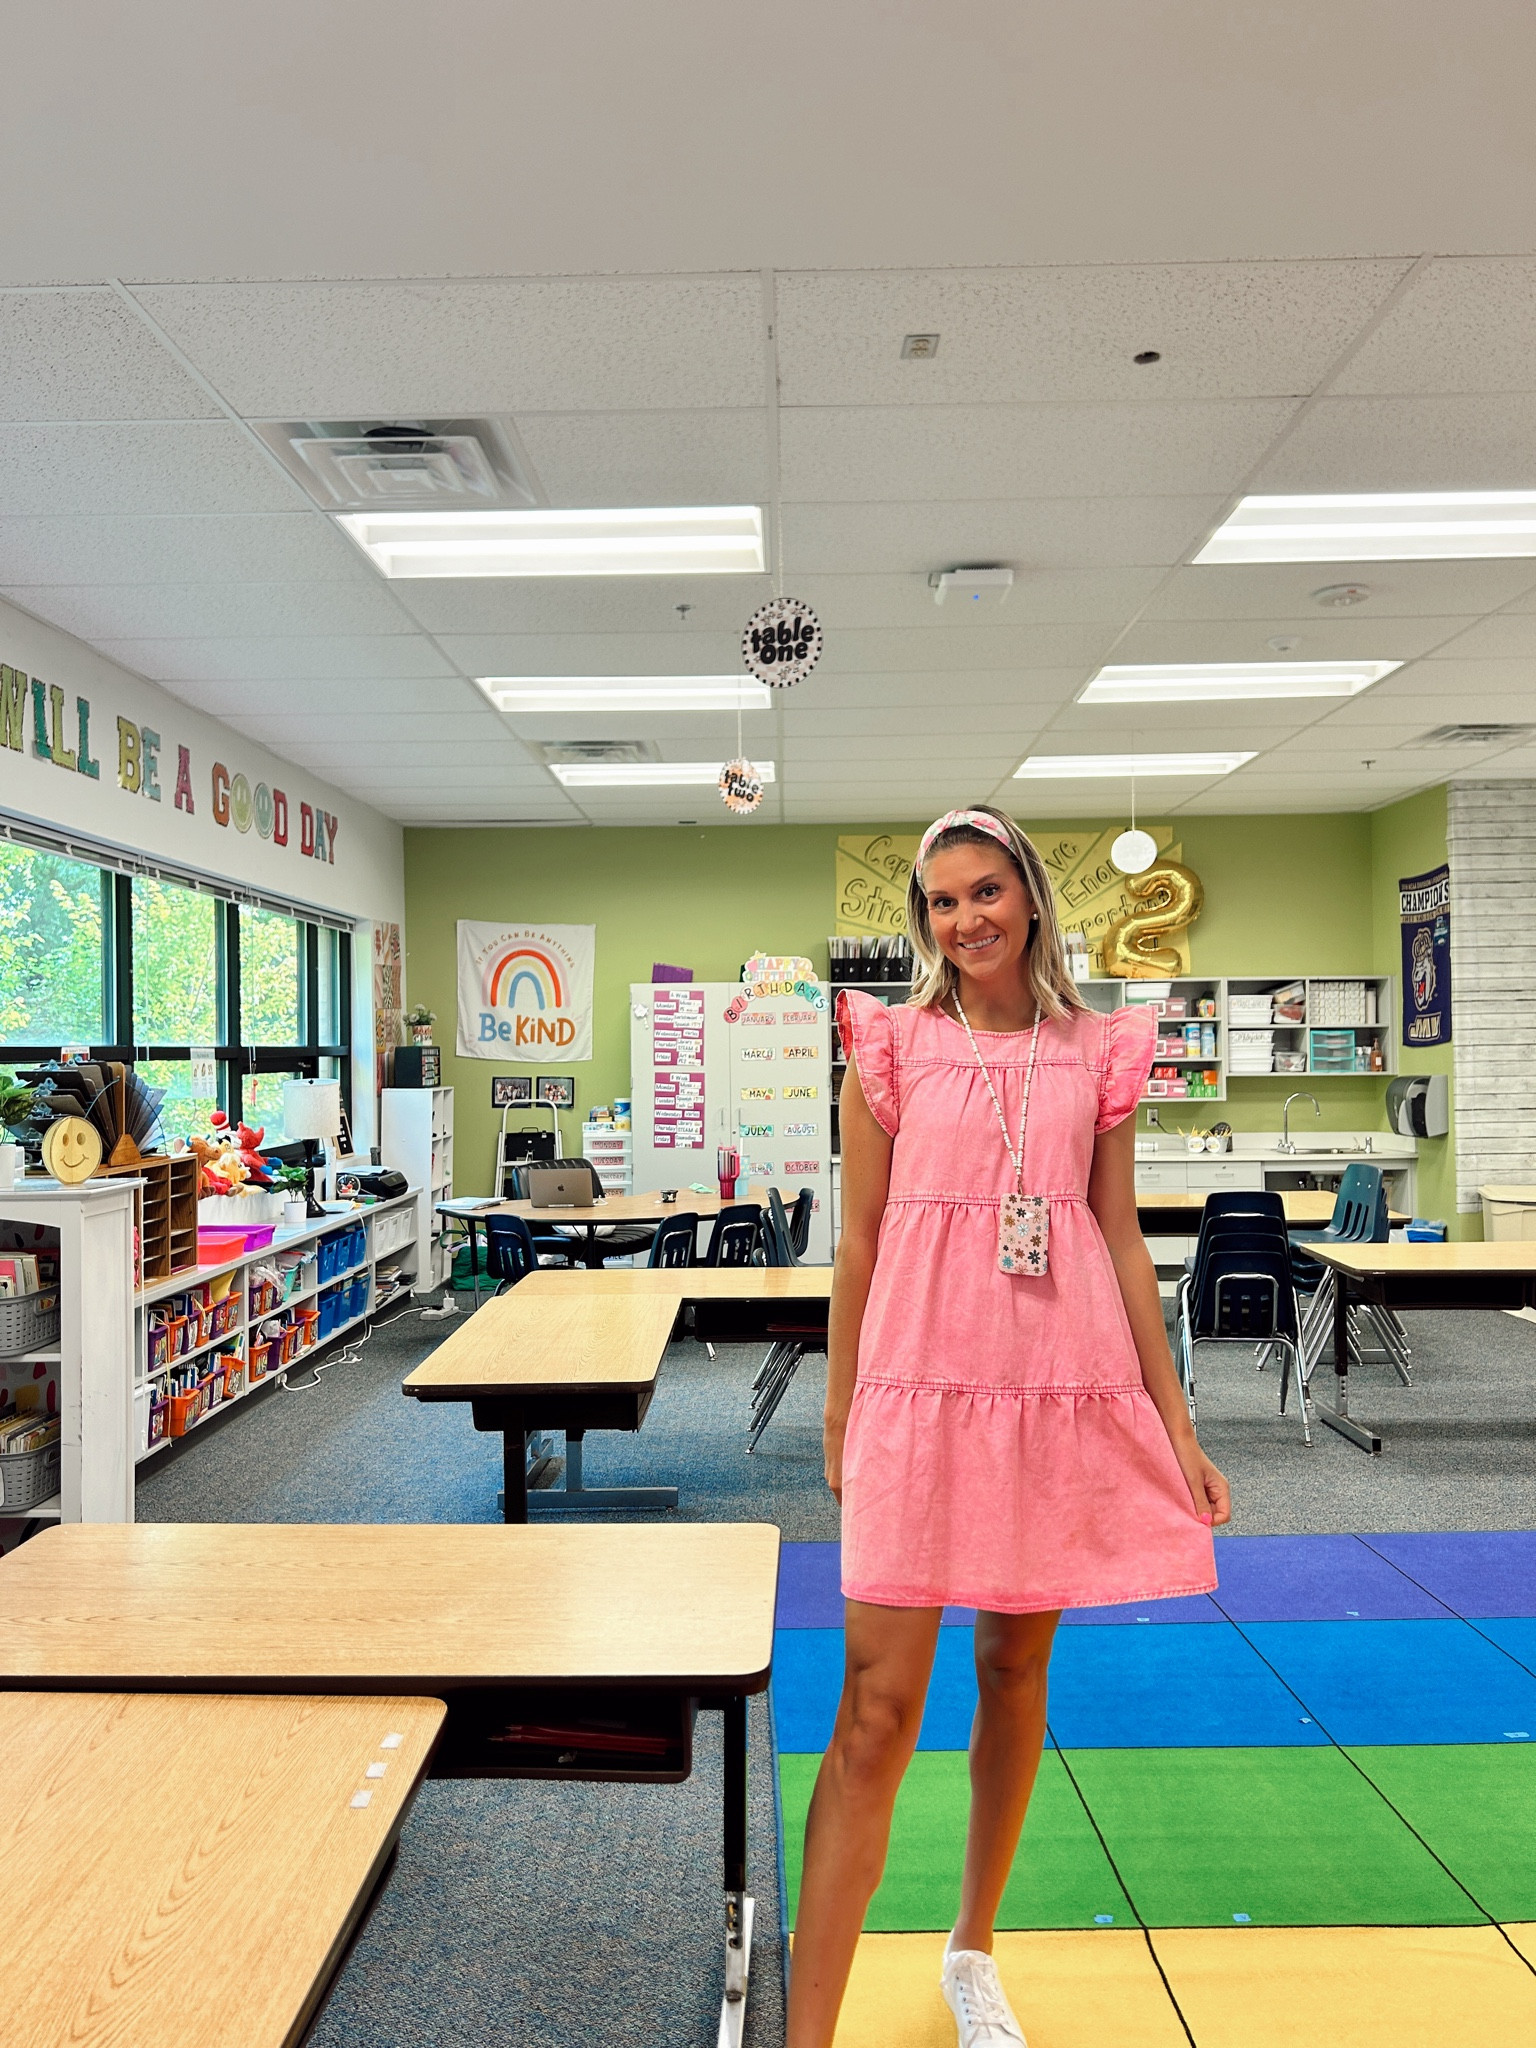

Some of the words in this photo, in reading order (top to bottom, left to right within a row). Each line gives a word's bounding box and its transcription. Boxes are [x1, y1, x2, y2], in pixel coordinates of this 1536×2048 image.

[750, 617, 814, 653] table
[760, 642, 808, 664] one
[0, 663, 100, 780] WILL
[117, 715, 161, 802] BE
[174, 744, 195, 815] A
[211, 761, 289, 847] GOOD
[300, 801, 338, 865] DAY
[725, 770, 759, 794] table
[728, 782, 754, 802] two
[865, 835, 911, 880] Cap
[841, 878, 906, 929] Stro
[1401, 882, 1449, 912] CHAMPIONS
[758, 958, 799, 970] HAPPY
[726, 982, 825, 1020] BIRTHDAYS
[477, 1012, 512, 1042] Be
[516, 1014, 575, 1046] KiND
[744, 1050, 773, 1058] MARCH
[788, 1049, 814, 1057] APRIL
[749, 1090, 767, 1098] MAY
[788, 1088, 811, 1097] JUNE
[745, 1126, 767, 1136] JULY
[787, 1126, 815, 1134] AUGUST
[786, 1163, 818, 1172] OCTOBER
